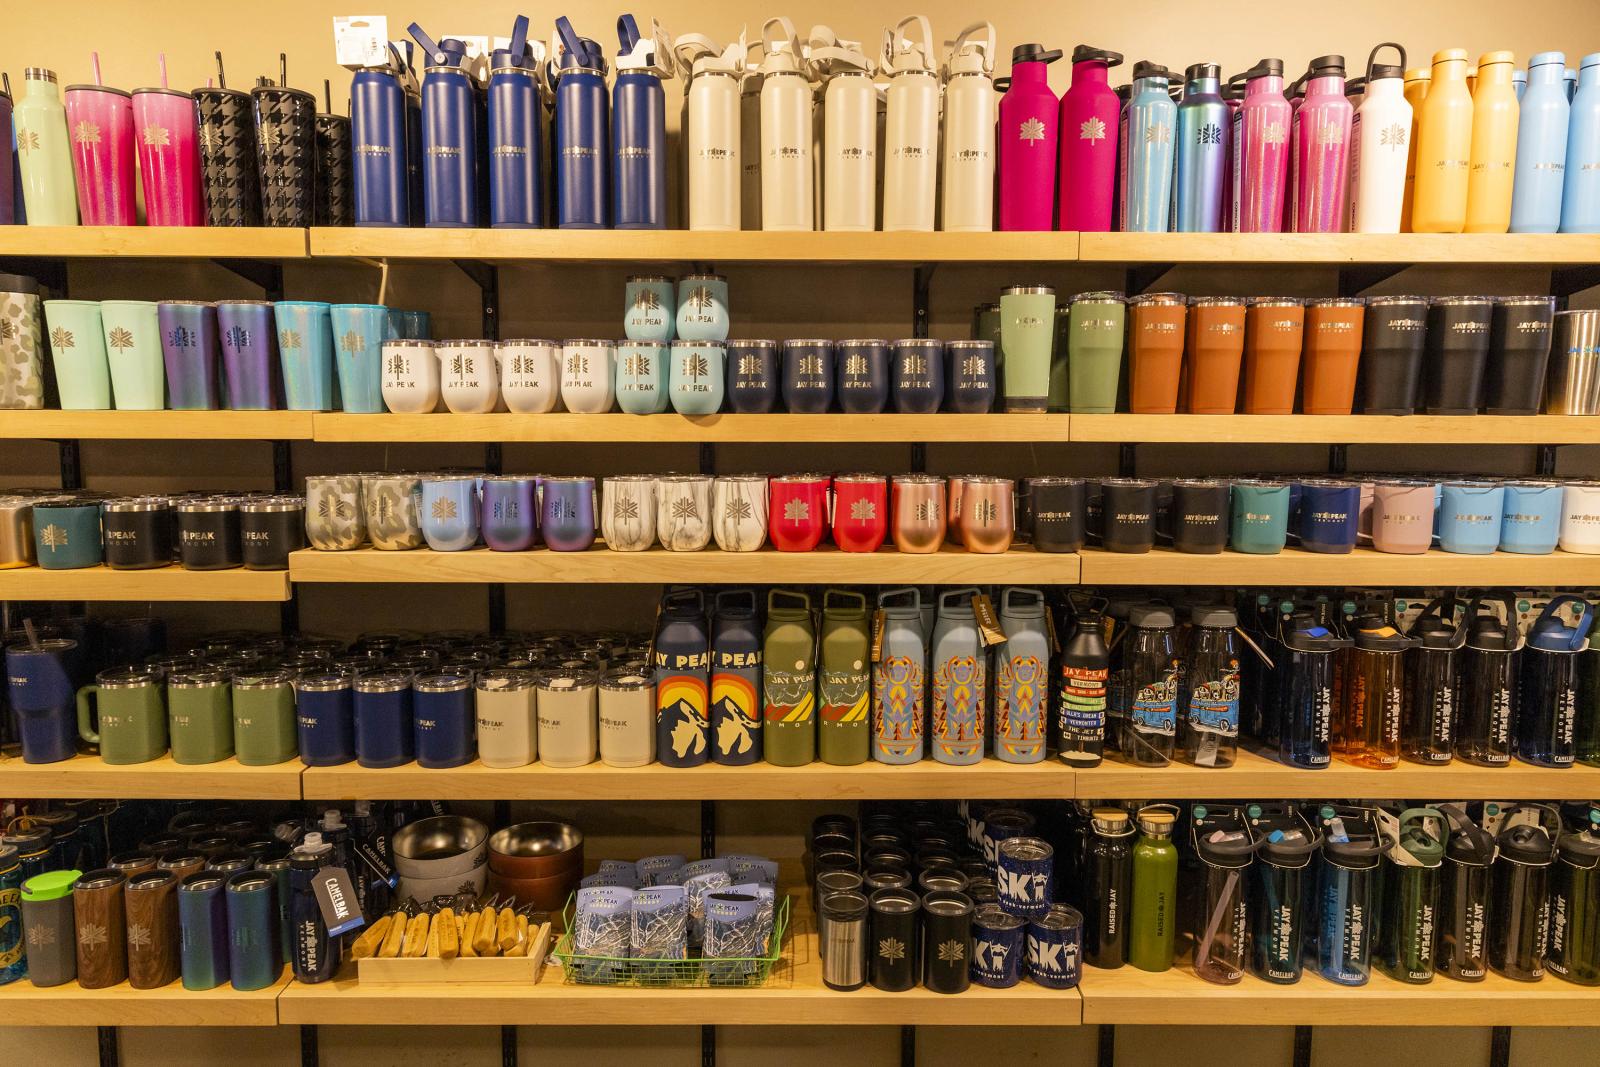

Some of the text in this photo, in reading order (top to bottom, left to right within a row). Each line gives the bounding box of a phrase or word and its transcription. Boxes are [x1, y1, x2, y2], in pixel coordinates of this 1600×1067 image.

[960, 381, 990, 389] JAY PEAK
[1569, 513, 1584, 521] JAY
[112, 531, 136, 540] PEAK
[190, 532, 215, 540] PEAK
[246, 532, 269, 540] PEAK
[772, 673, 815, 684] JAY PEAK
[830, 675, 848, 684] JAY
[1064, 667, 1081, 676] JAY
[1085, 670, 1107, 679] PEAK
[1321, 686, 1330, 742] JAY PEAK
[1391, 716, 1399, 742] PEAK
[1441, 686, 1452, 742] JAY PEAK
[1492, 693, 1500, 738] VERMONT
[1498, 688, 1510, 744] JAY PEAK
[1564, 688, 1575, 744] JAY PEAK
[325, 877, 349, 920] CAMELBAK
[1557, 894, 1566, 914] JAY
[1108, 909, 1116, 934] RAISED
[1279, 905, 1291, 961] JAY PEAK
[1350, 904, 1362, 960] JAY PEAK
[1414, 909, 1422, 955] VERMONT
[1421, 905, 1433, 960] JAY PEAK
[1472, 903, 1483, 958] JAY PEAK
[1553, 925, 1563, 952] PEAK
[305, 921, 316, 971] JAY PEAK
